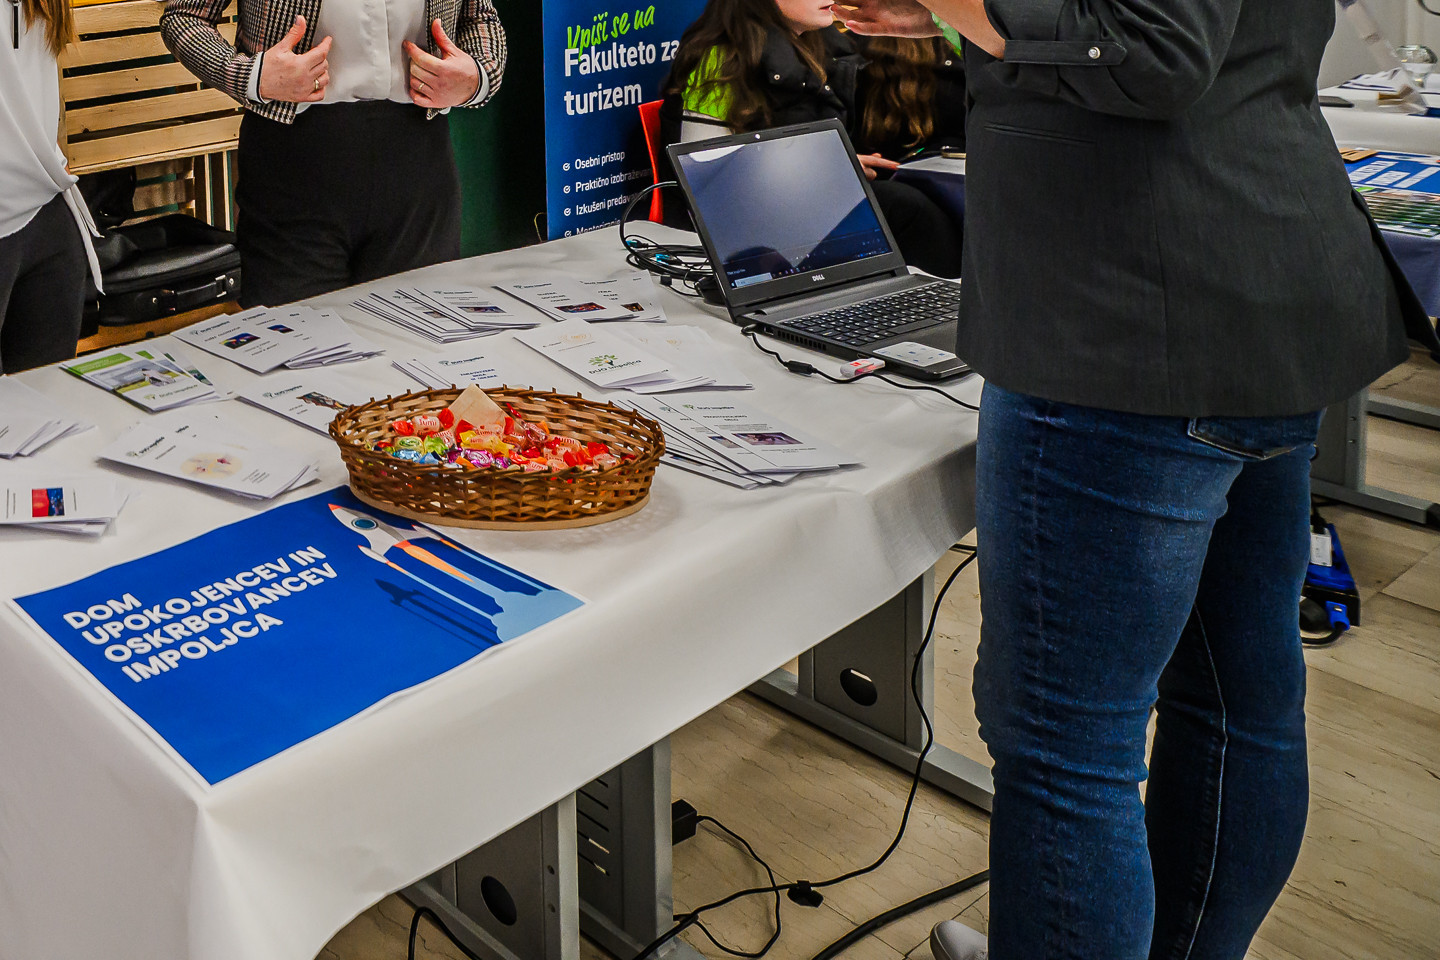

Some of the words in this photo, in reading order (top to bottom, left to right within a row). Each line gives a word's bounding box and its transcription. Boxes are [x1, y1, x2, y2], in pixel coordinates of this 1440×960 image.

[567, 12, 608, 61] Vpiši
[611, 13, 630, 38] se
[634, 6, 655, 30] na
[565, 42, 656, 76] Fakulteto
[564, 83, 642, 115] turizem
[575, 154, 600, 169] Osebni
[602, 151, 625, 163] pristop
[576, 176, 609, 192] Praktično
[576, 199, 605, 215] Izkušeni
[63, 593, 141, 629] DOM
[82, 558, 291, 644] UPOKOJENCEV
[289, 546, 326, 566] IN
[105, 563, 337, 662] OSKRBOVANCEV
[122, 613, 283, 682] IMPOLJCA
